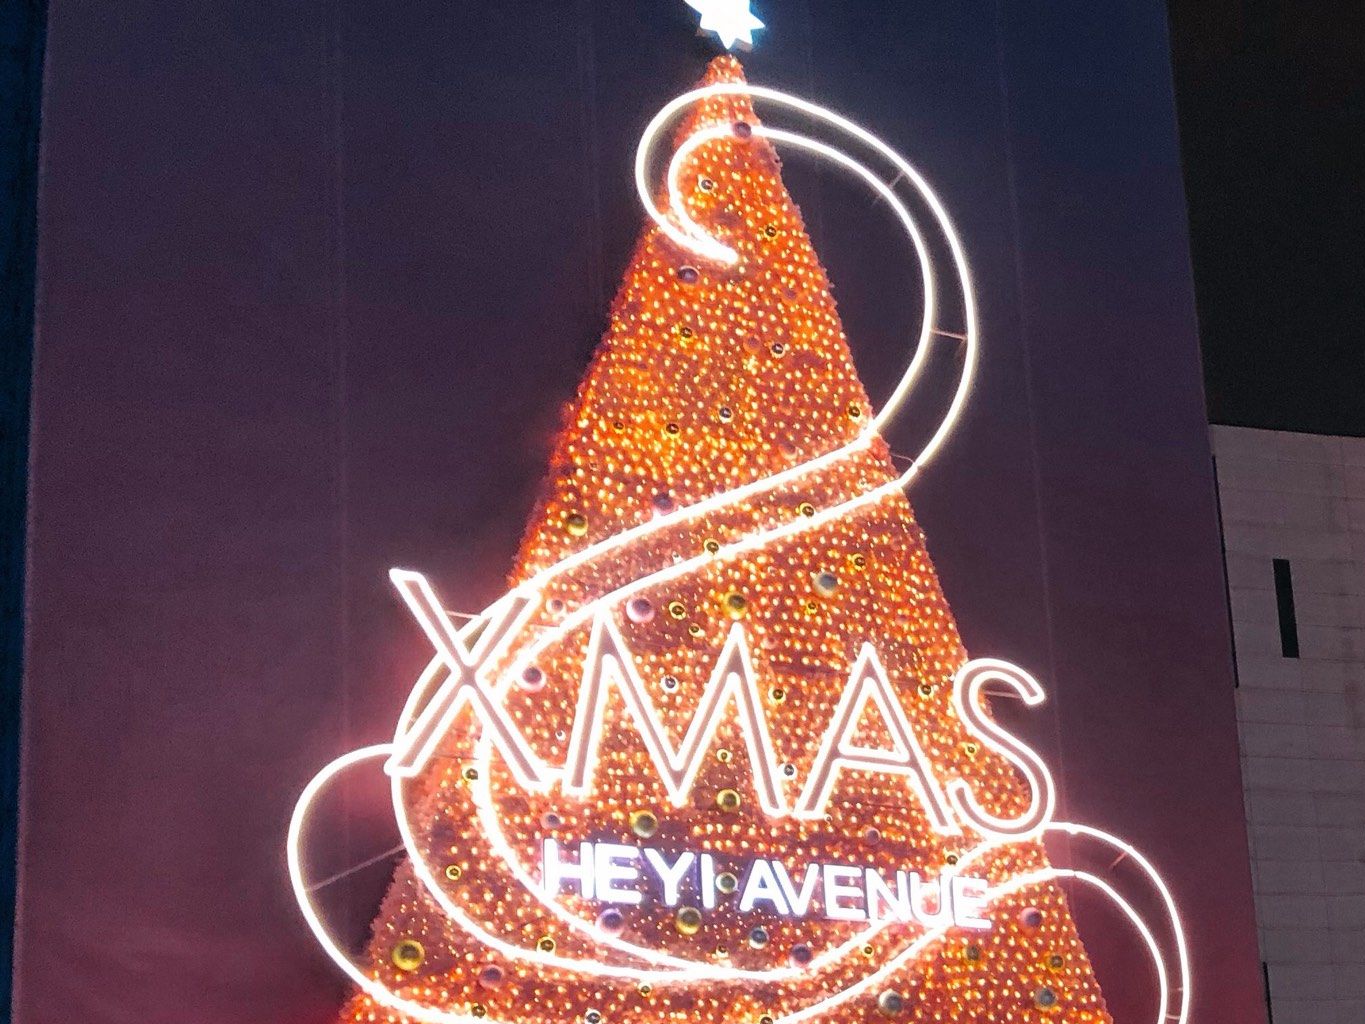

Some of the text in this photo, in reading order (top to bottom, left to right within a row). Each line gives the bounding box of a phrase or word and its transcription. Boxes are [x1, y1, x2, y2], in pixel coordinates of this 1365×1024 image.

[384, 566, 1057, 842] XMAS
[543, 838, 993, 930] HEYI AVENUE
